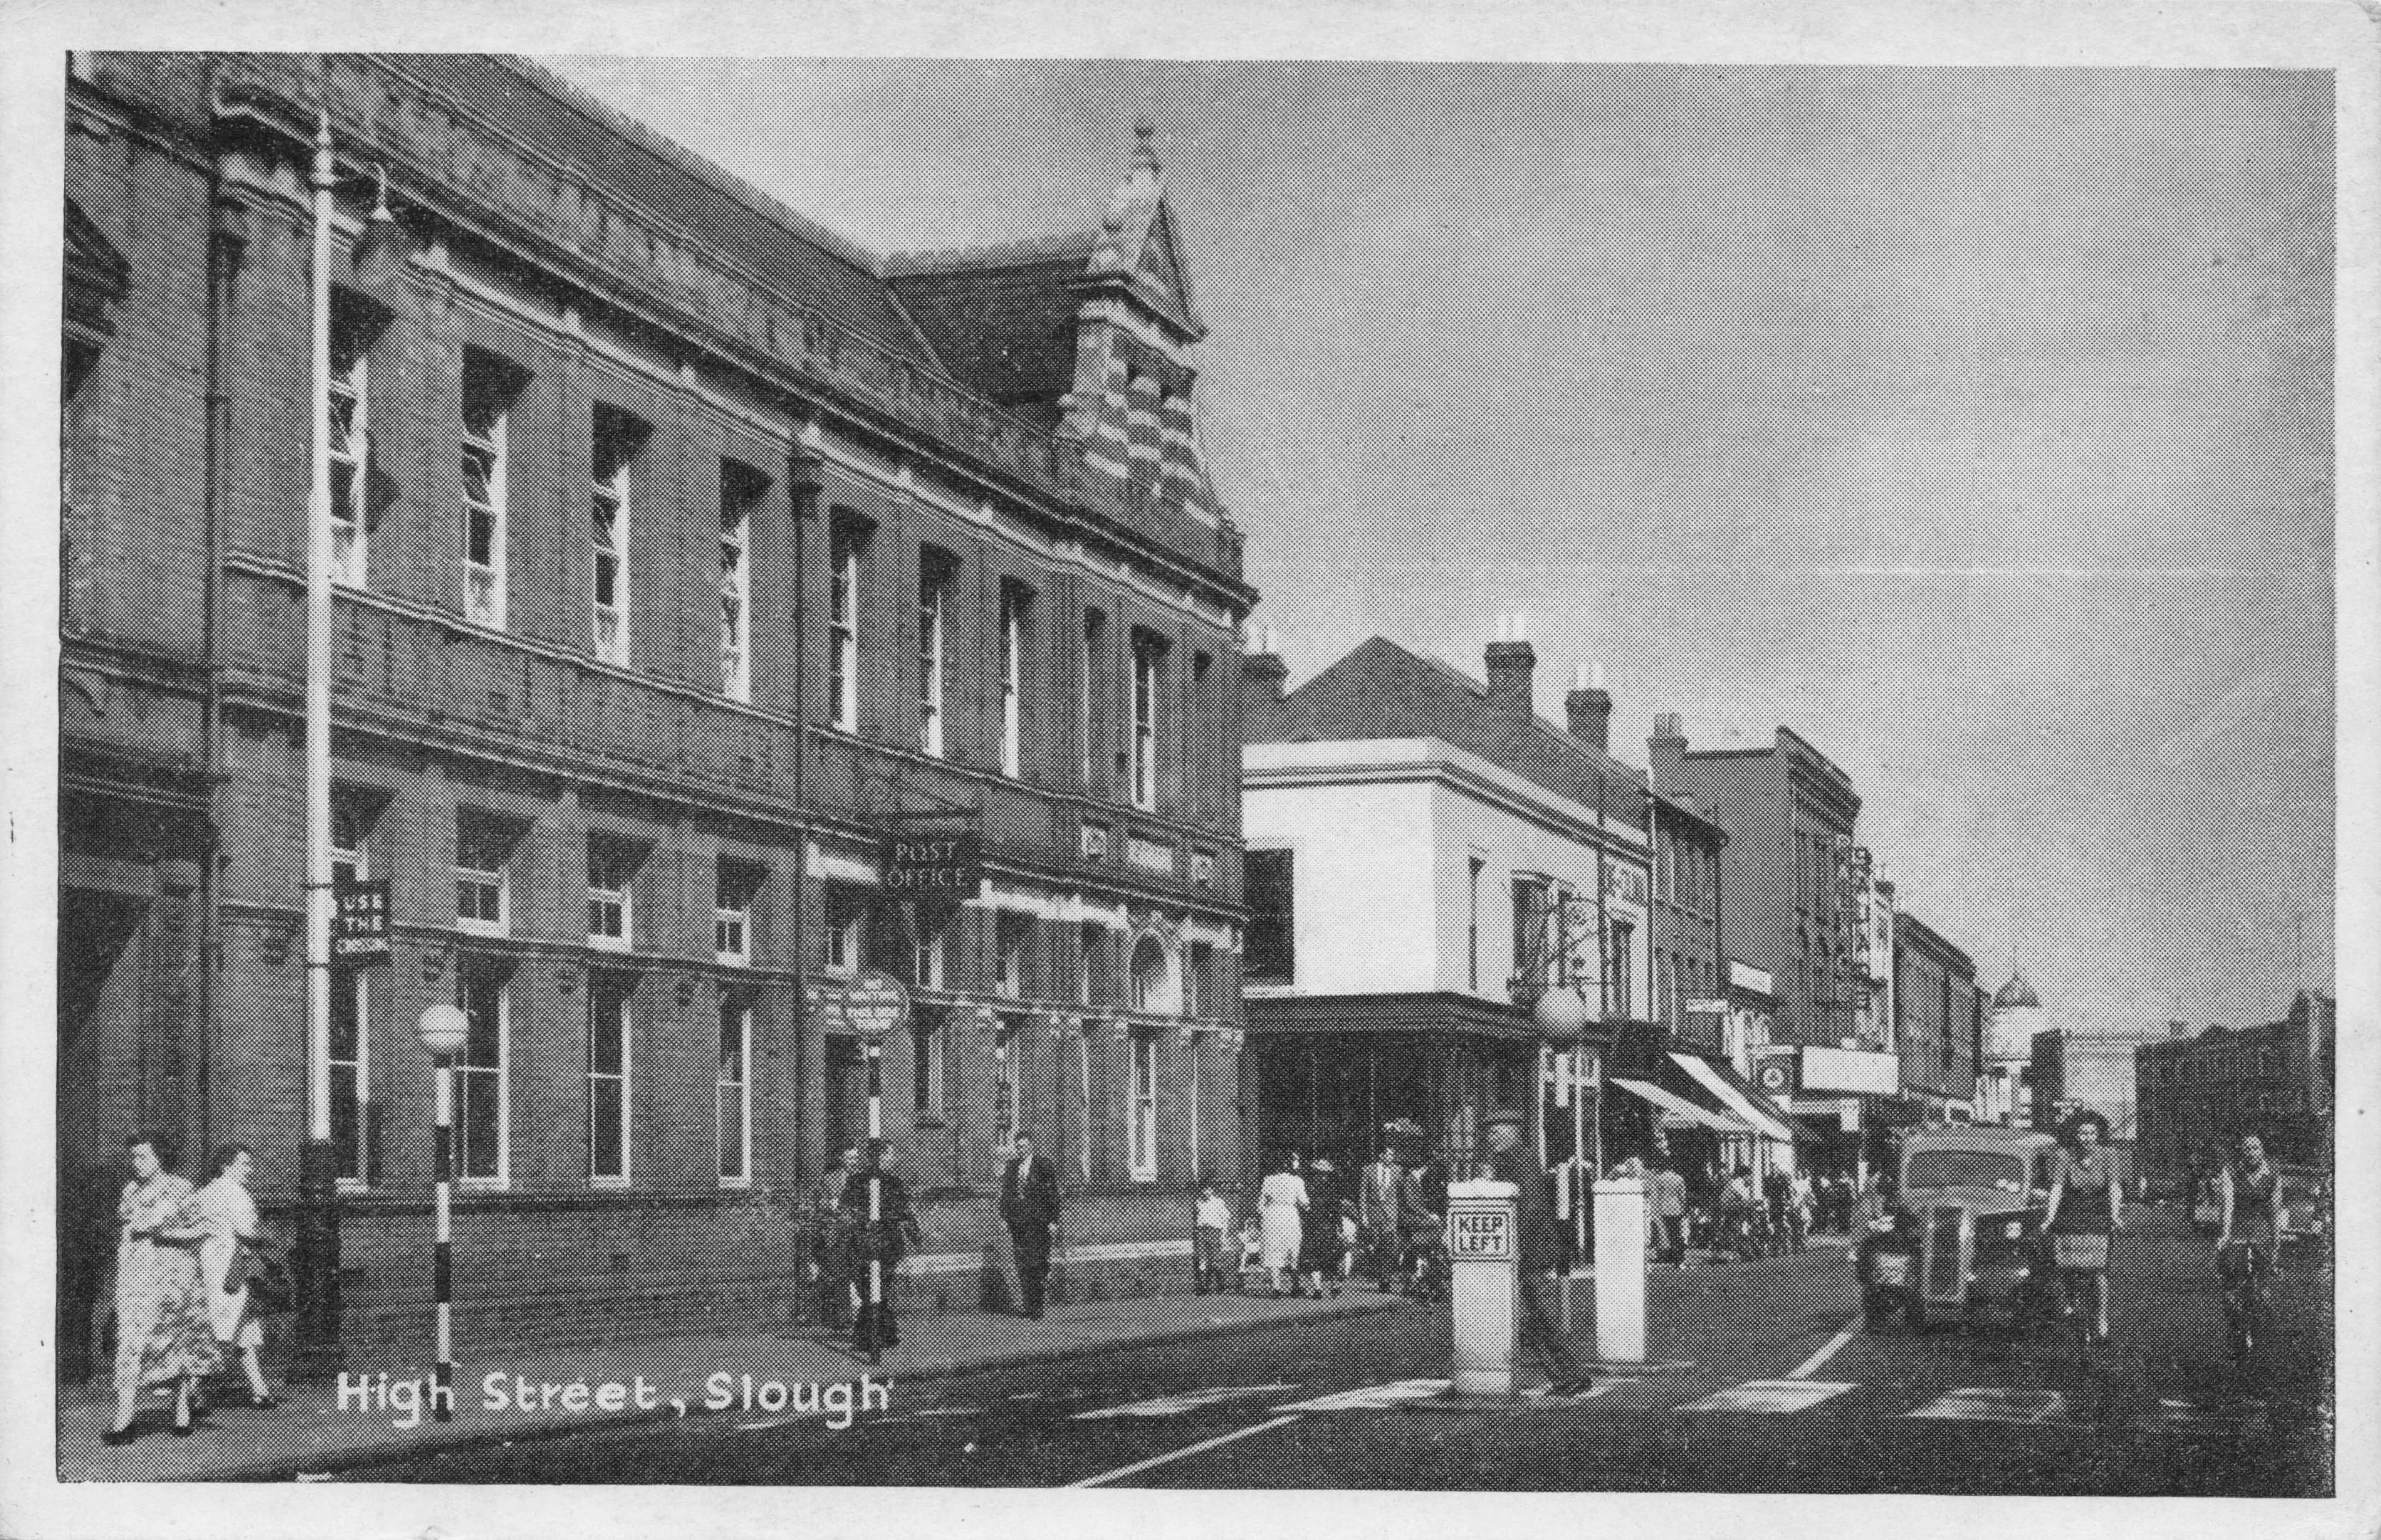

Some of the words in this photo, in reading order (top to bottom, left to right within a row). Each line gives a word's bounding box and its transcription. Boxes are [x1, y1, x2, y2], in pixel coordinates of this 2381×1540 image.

[896, 842, 957, 861] POST
[886, 866, 968, 888] OFFICE
[343, 894, 382, 911] USE
[344, 916, 382, 932] THE
[849, 990, 899, 1002] WAITING
[846, 1007, 872, 1018] THIS
[874, 1007, 899, 1018] SIDE
[1458, 1216, 1503, 1233] KEEP
[1458, 1235, 1502, 1252] LEFT
